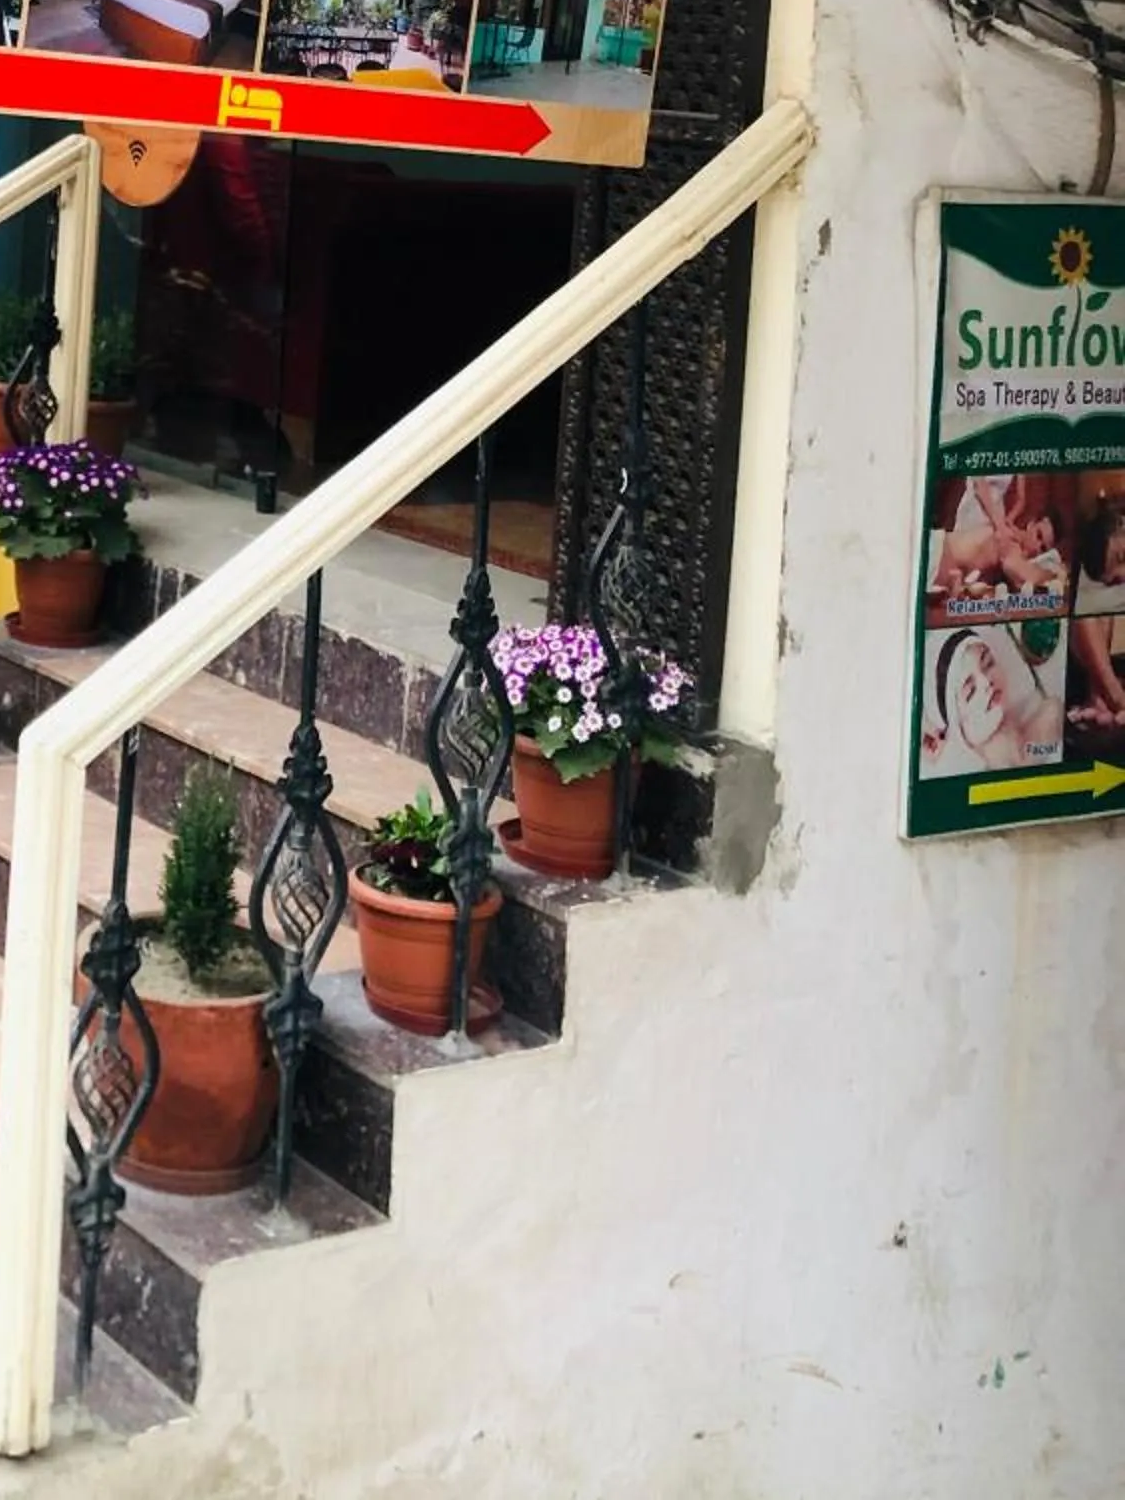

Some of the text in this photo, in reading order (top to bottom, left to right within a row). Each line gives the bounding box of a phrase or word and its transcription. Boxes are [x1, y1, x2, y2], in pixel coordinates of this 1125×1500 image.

[956, 381, 986, 411] Spa
[992, 381, 1060, 410] Therapy
[1064, 380, 1077, 404] &
[1026, 742, 1058, 757] Facial
